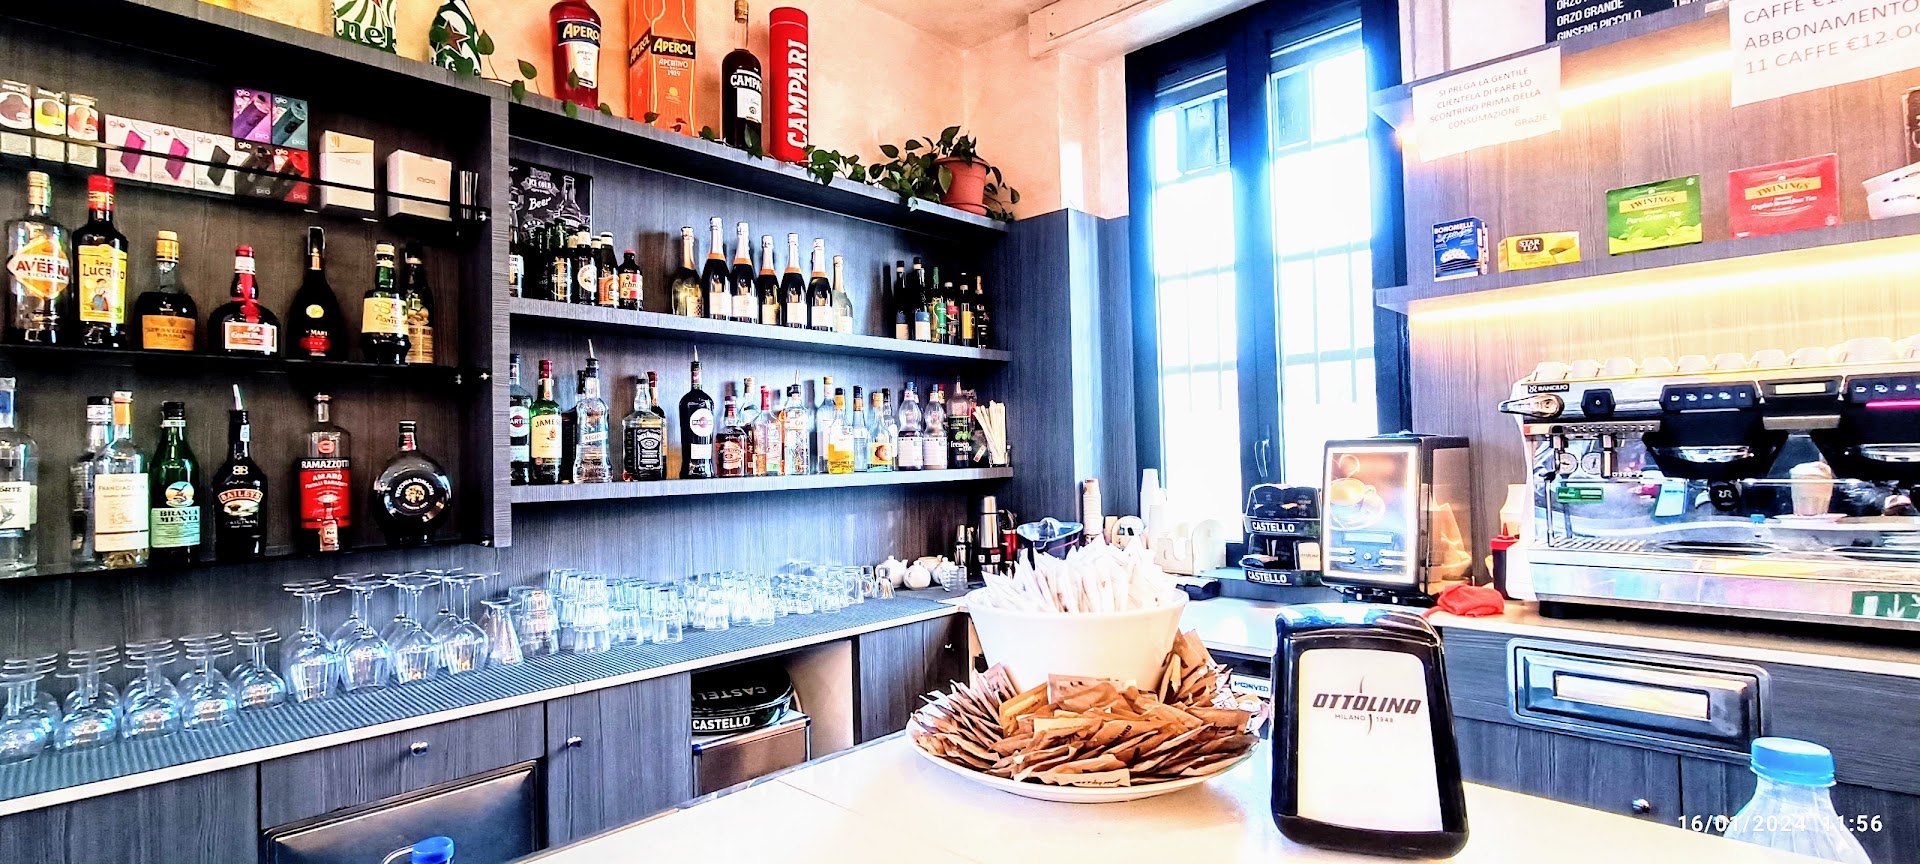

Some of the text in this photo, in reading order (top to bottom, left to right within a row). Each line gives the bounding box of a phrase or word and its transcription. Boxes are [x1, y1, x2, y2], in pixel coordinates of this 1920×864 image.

[1556, 1, 1625, 27] ORZO GRANDE
[1557, 9, 1642, 41] GINSENG PICCOLO
[1744, 0, 1919, 50] ABBONAMENTO
[654, 38, 693, 55] APEROL
[1745, 59, 1767, 75] 11
[1775, 41, 1839, 67] CAFFE
[1439, 67, 1528, 97] SI PREGA LA GENTILE
[237, 88, 250, 97] glo
[787, 39, 807, 149] CAMPARI
[1437, 79, 1532, 109] CLIENTELA DI FARE LO
[275, 96, 288, 104] glo
[1430, 89, 1541, 124] SCONTRINO PRIMA DELLA
[1448, 106, 1521, 129] CONSUMAZIONE
[1514, 113, 1548, 127] GRAZIE
[109, 120, 126, 128] glo
[154, 128, 170, 136] glo
[255, 132, 270, 140] pro
[197, 135, 212, 143] glo
[238, 141, 252, 149] glo
[275, 148, 288, 156] glo
[1757, 182, 1810, 196] TWININGS
[293, 192, 307, 201] pro
[1630, 196, 1675, 209] TWININGS
[528, 197, 551, 210] Beer
[1518, 238, 1541, 247] STAR
[1523, 244, 1539, 252] TEA
[301, 460, 349, 468] RAMAZZOTTI
[313, 473, 342, 481] AMARO
[220, 491, 260, 499] BAILEYS
[1252, 521, 1295, 532] CASTELLO
[1247, 571, 1287, 583] CASTELLO
[1313, 693, 1421, 715] OTTOLINA
[692, 716, 751, 730] CASTELLO
